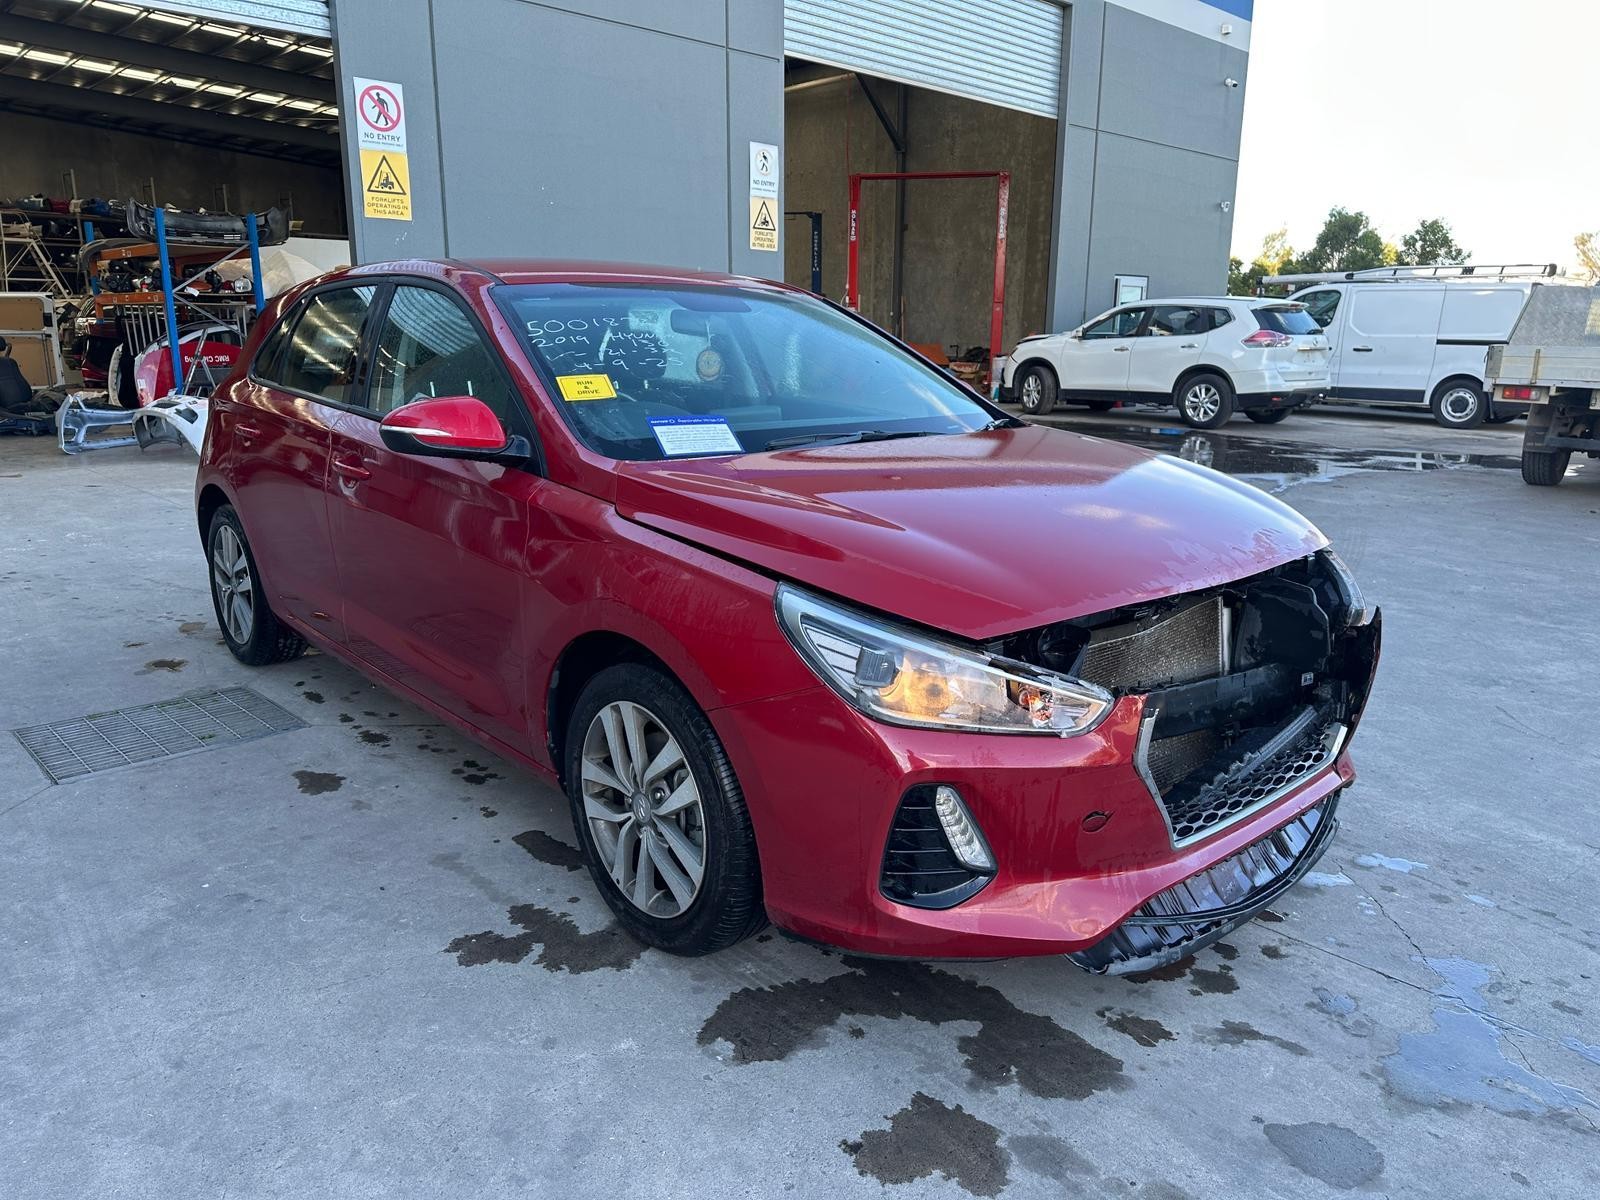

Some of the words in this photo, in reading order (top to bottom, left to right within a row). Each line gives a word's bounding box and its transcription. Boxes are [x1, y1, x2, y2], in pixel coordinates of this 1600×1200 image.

[377, 133, 400, 142] ENTRY
[760, 180, 775, 188] ENTRY
[371, 196, 404, 204] FORKLIFTS
[367, 201, 400, 210] OPERATING
[532, 335, 590, 347] 2019
